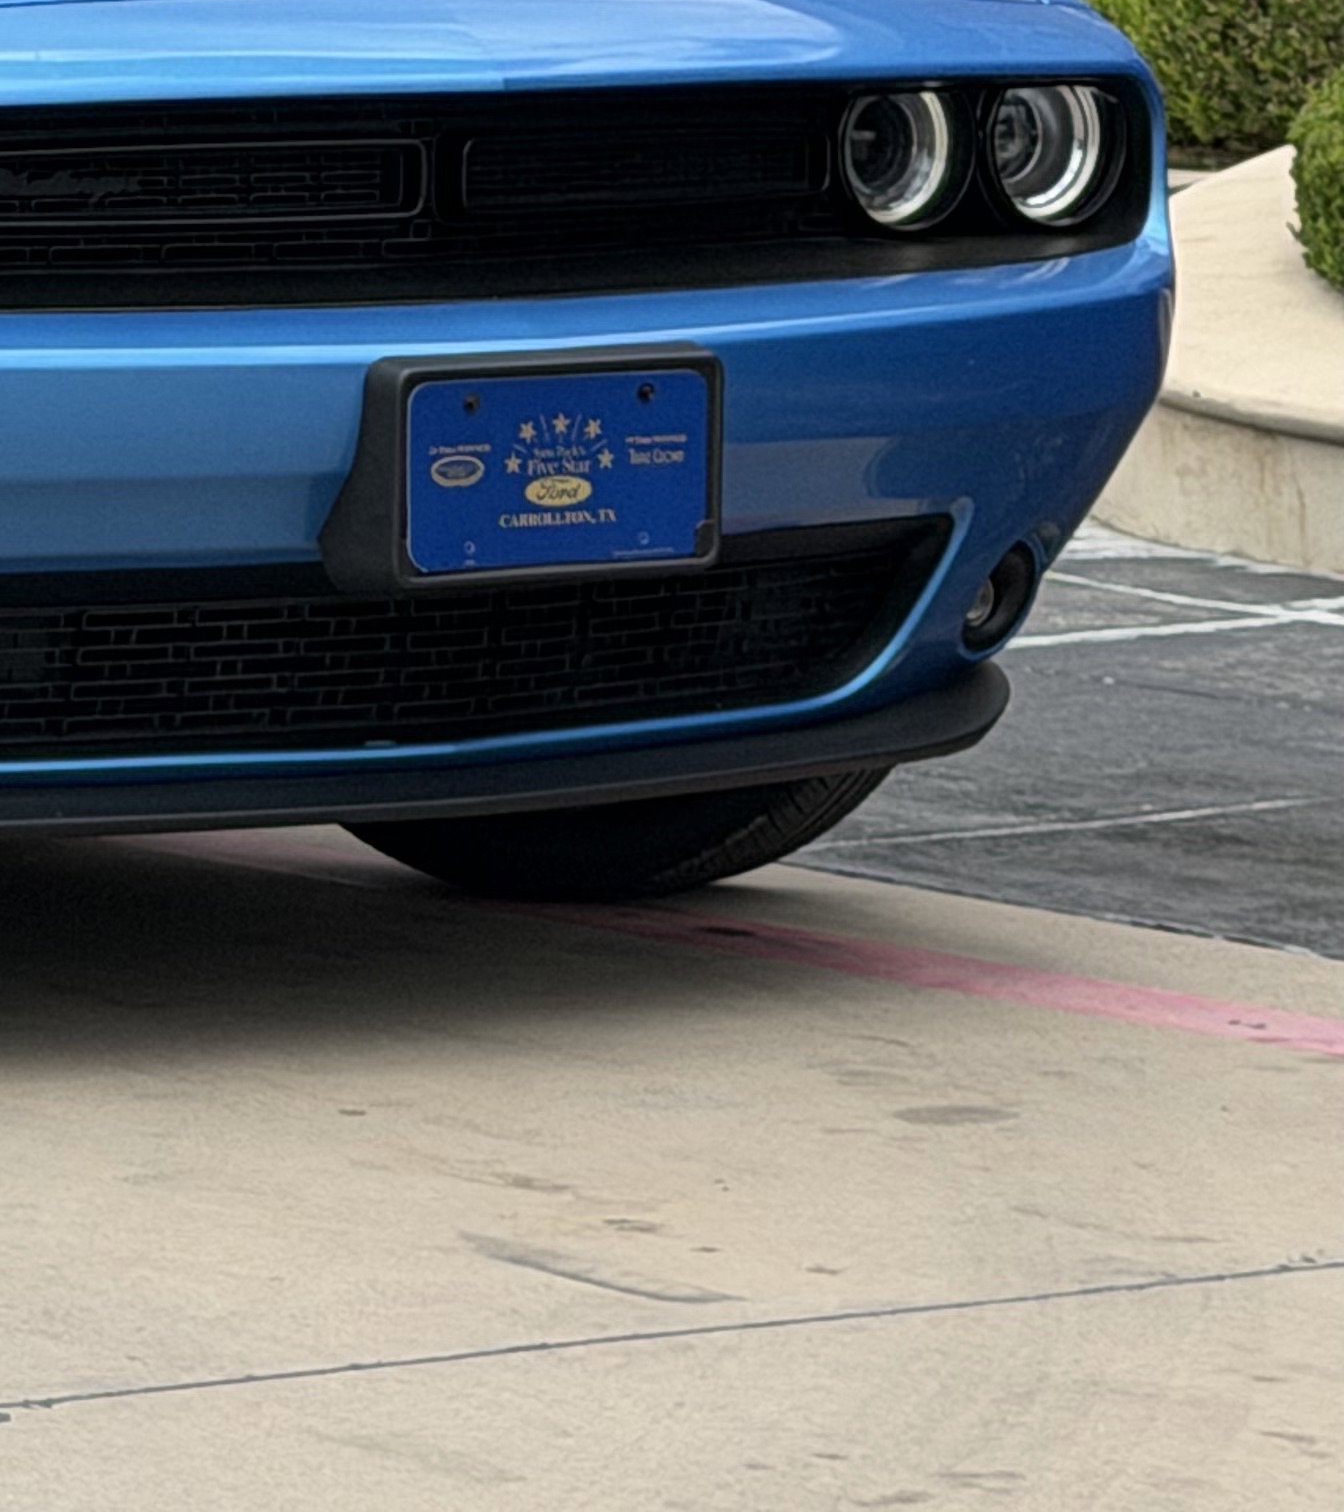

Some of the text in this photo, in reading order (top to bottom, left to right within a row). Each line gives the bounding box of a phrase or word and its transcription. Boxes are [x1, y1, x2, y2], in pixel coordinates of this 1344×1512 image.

[527, 454, 592, 476] Five Star
[535, 478, 582, 501] Ford
[597, 508, 617, 523] TX
